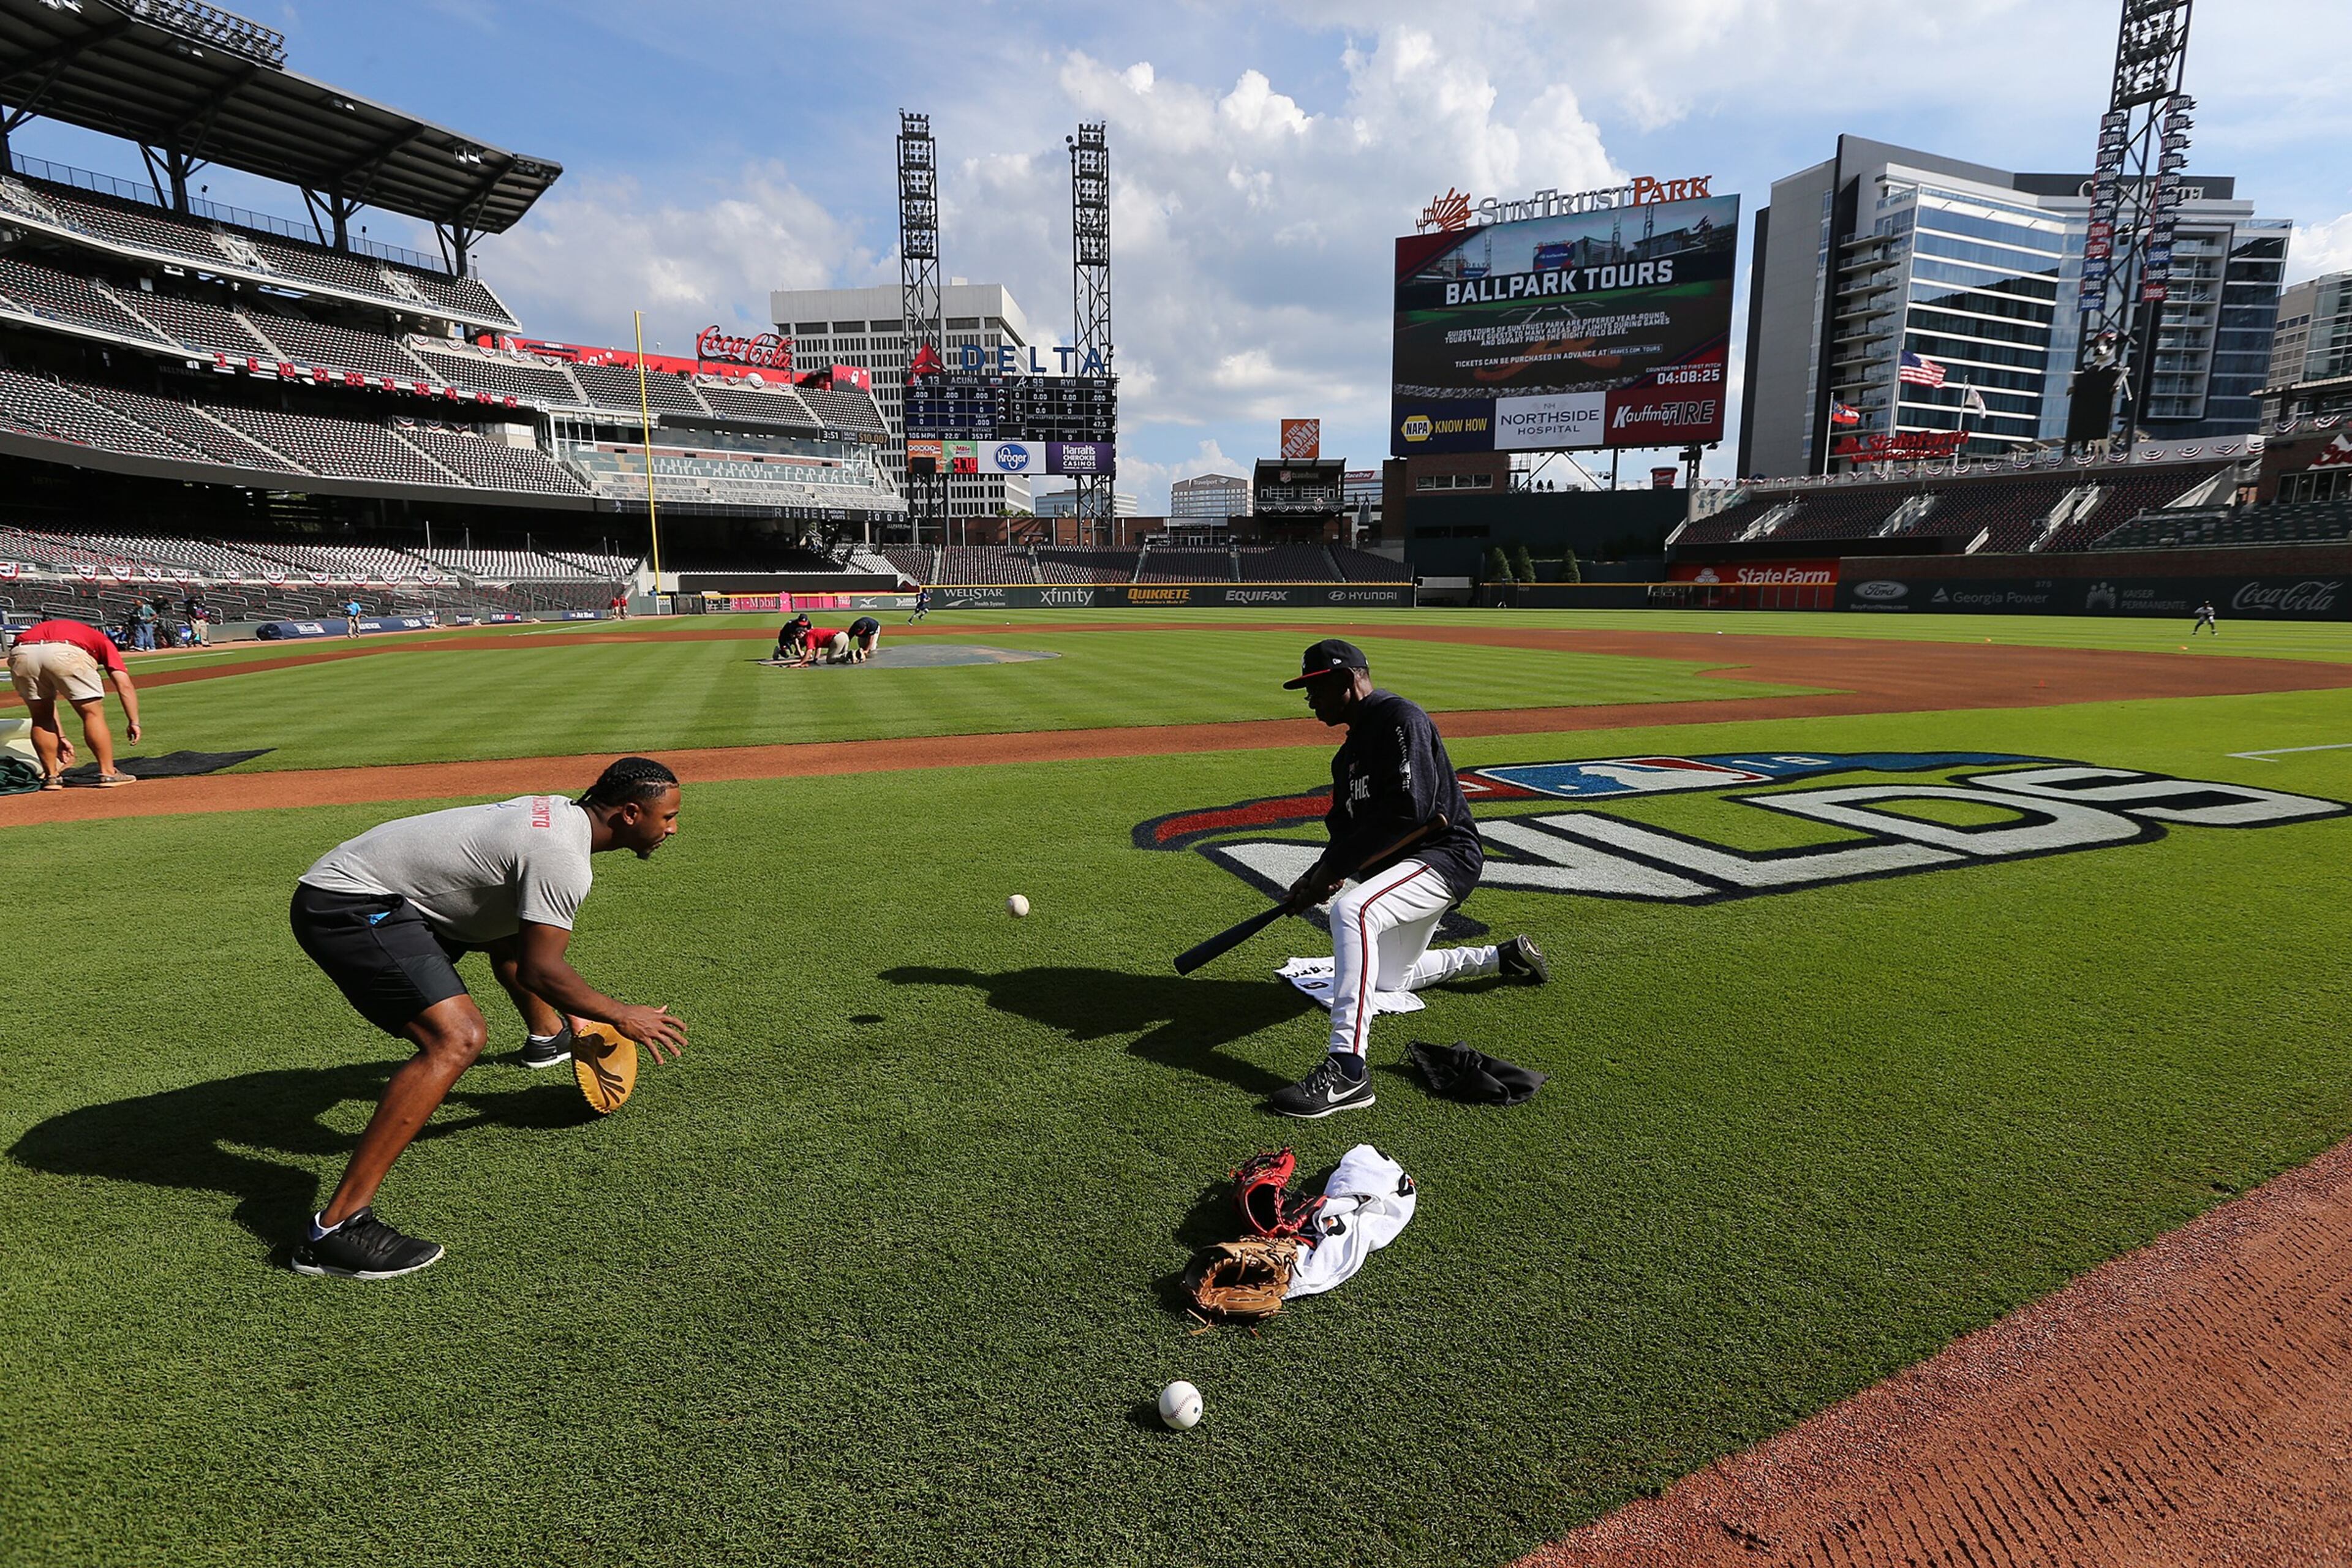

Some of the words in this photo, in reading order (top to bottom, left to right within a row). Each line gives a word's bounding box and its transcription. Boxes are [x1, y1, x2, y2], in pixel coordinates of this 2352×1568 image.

[1447, 270, 1578, 305] BALLPARK
[1585, 260, 1673, 290] TOURS
[1447, 329, 1471, 337] GUIDED
[1507, 323, 1544, 332] SUNTRUST
[1583, 316, 1615, 325] OFFERED
[1587, 322, 1612, 331] LIMITS
[1614, 319, 1642, 328] DURING
[1643, 317, 1671, 326] GAMES
[1562, 331, 1583, 339] RIGHT
[1607, 327, 1629, 336] GATE.
[696, 325, 796, 369] Coca-Cola
[214, 353, 226, 367] 3
[247, 357, 260, 372] 6
[962, 344, 1104, 373] DELTA
[1455, 359, 1483, 368] TICKETS
[1510, 353, 1552, 363] PURCHASED
[1563, 350, 1596, 360] ADVANCE
[277, 363, 295, 377] 10
[313, 367, 330, 382] 21
[1657, 369, 1720, 385] 04:08:25
[344, 372, 365, 386] 29
[380, 377, 397, 391] 31
[928, 375, 940, 385] 13
[951, 375, 979, 385] ACUÑA
[1033, 378, 1044, 387] 99
[412, 382, 431, 396] 35
[444, 387, 459, 401] 41
[475, 392, 493, 404] 44
[533, 399, 549, 413] 42
[1501, 409, 1600, 426] NORTHSIDE
[1612, 404, 1678, 428] Kauffman
[1661, 400, 1716, 426] TIRE
[1284, 423, 1302, 440] THE
[1406, 421, 1428, 435] NAPA
[1435, 419, 1463, 434] KNOW
[1466, 418, 1488, 432] HOW
[1517, 424, 1581, 435] HOSPITAL
[823, 431, 839, 439] 3:51
[1281, 419, 1319, 458] HOME
[1063, 445, 1096, 454] Harrah's
[1295, 432, 1319, 458] DEPOT
[998, 448, 1027, 469] Kroger
[774, 507, 782, 518] R
[794, 508, 801, 518] H
[812, 508, 818, 518] E
[944, 588, 1005, 599] WELLSTAR
[1128, 588, 1190, 600] QUIKRETE
[1225, 590, 1287, 603] EQUIFAX
[1349, 592, 1398, 600] HYUNDAI
[1864, 583, 1896, 596] Ford
[2122, 589, 2154, 598] KAISER
[2231, 581, 2345, 611] Coca-Cola
[1041, 588, 1094, 606] xfinity
[1953, 592, 2003, 605] Georgia
[2007, 592, 2049, 603] Power
[2120, 600, 2187, 611] PERMANENTE
